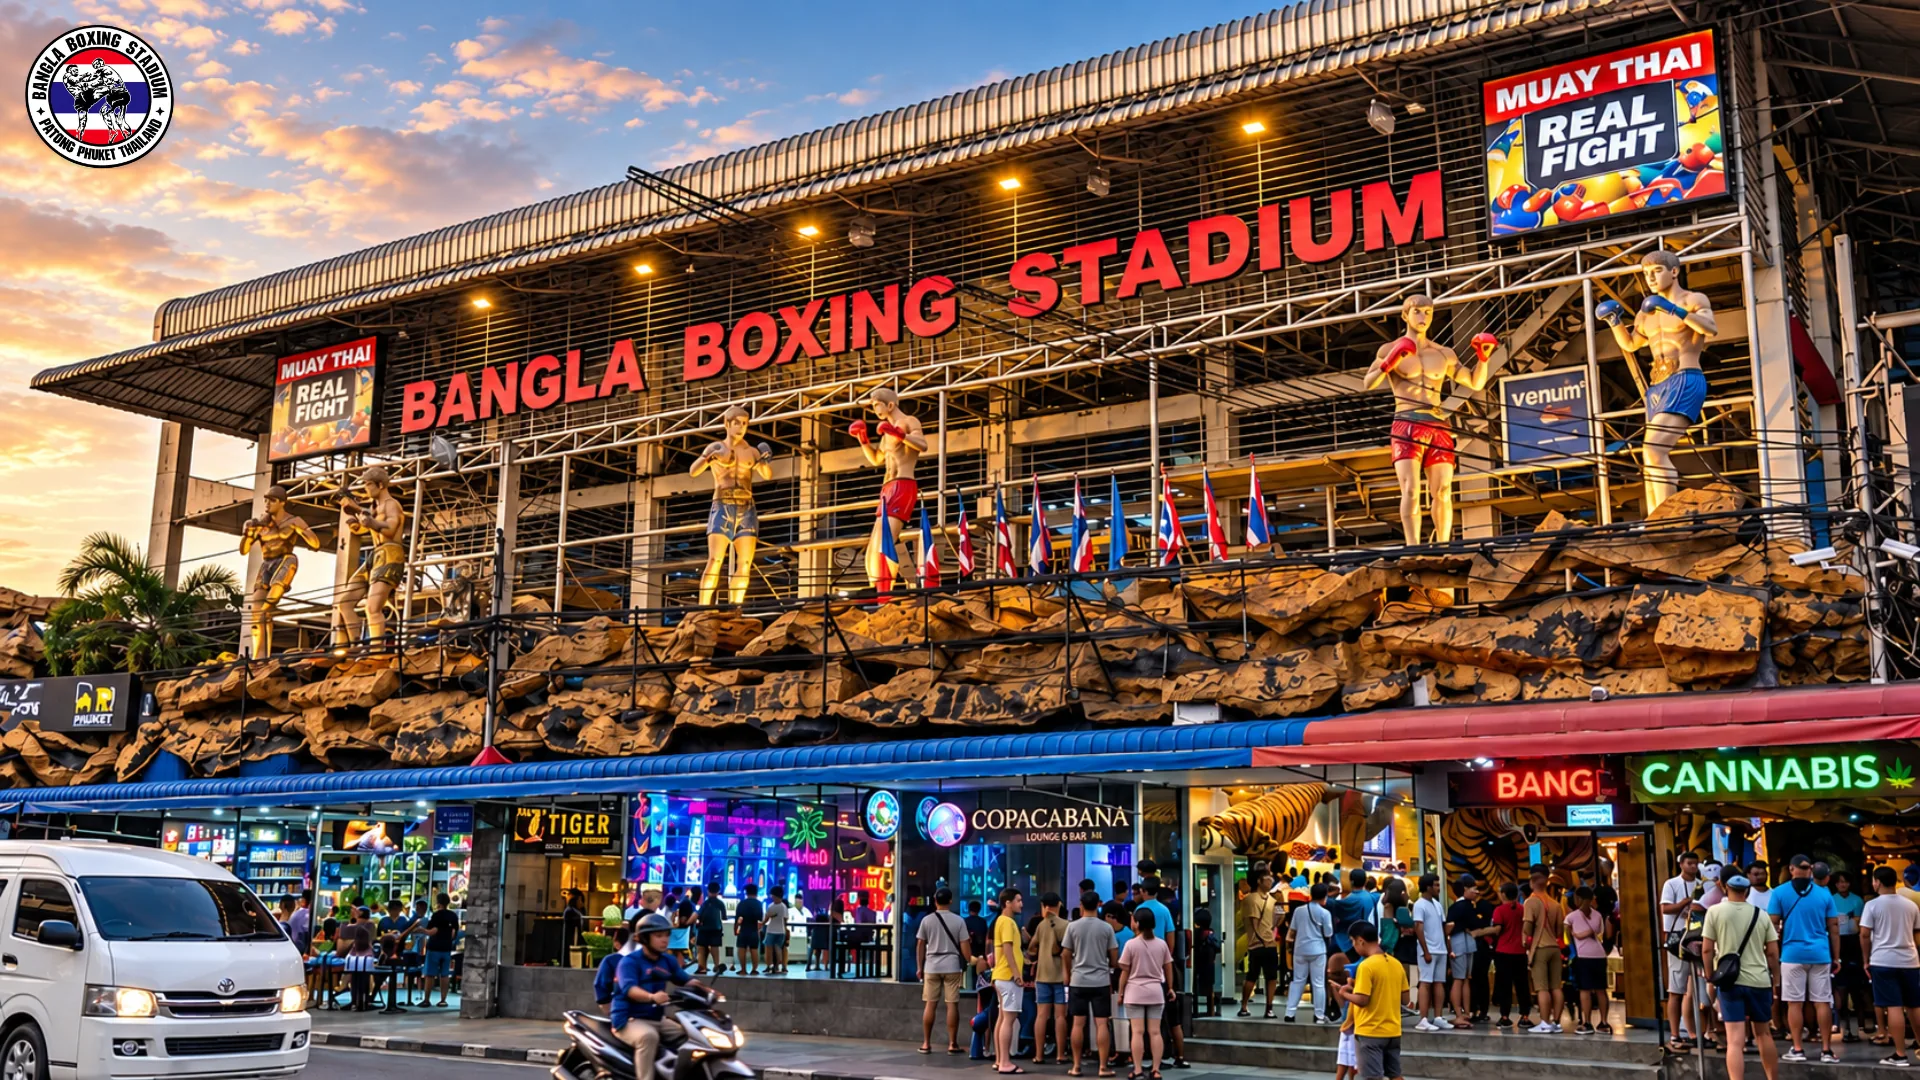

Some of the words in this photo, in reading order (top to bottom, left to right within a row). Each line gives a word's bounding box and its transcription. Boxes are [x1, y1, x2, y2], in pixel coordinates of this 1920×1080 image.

[1496, 65, 1601, 113] MUAY
[1609, 43, 1702, 84] THAI
[1538, 95, 1656, 148] REAL
[1540, 123, 1665, 178] FIGHT
[401, 338, 647, 434] BANGLA
[683, 275, 958, 382] BOXING
[1007, 169, 1447, 319] STADIUM
[281, 354, 328, 380] MUAY
[331, 344, 371, 368] THAI
[296, 376, 347, 404] REAL
[294, 396, 349, 423] FIGHT
[1641, 754, 1880, 795] CANNABIS
[549, 813, 610, 835] TIGER
[1026, 832, 1060, 842] LOUNGE
[1069, 831, 1087, 841] BAR
